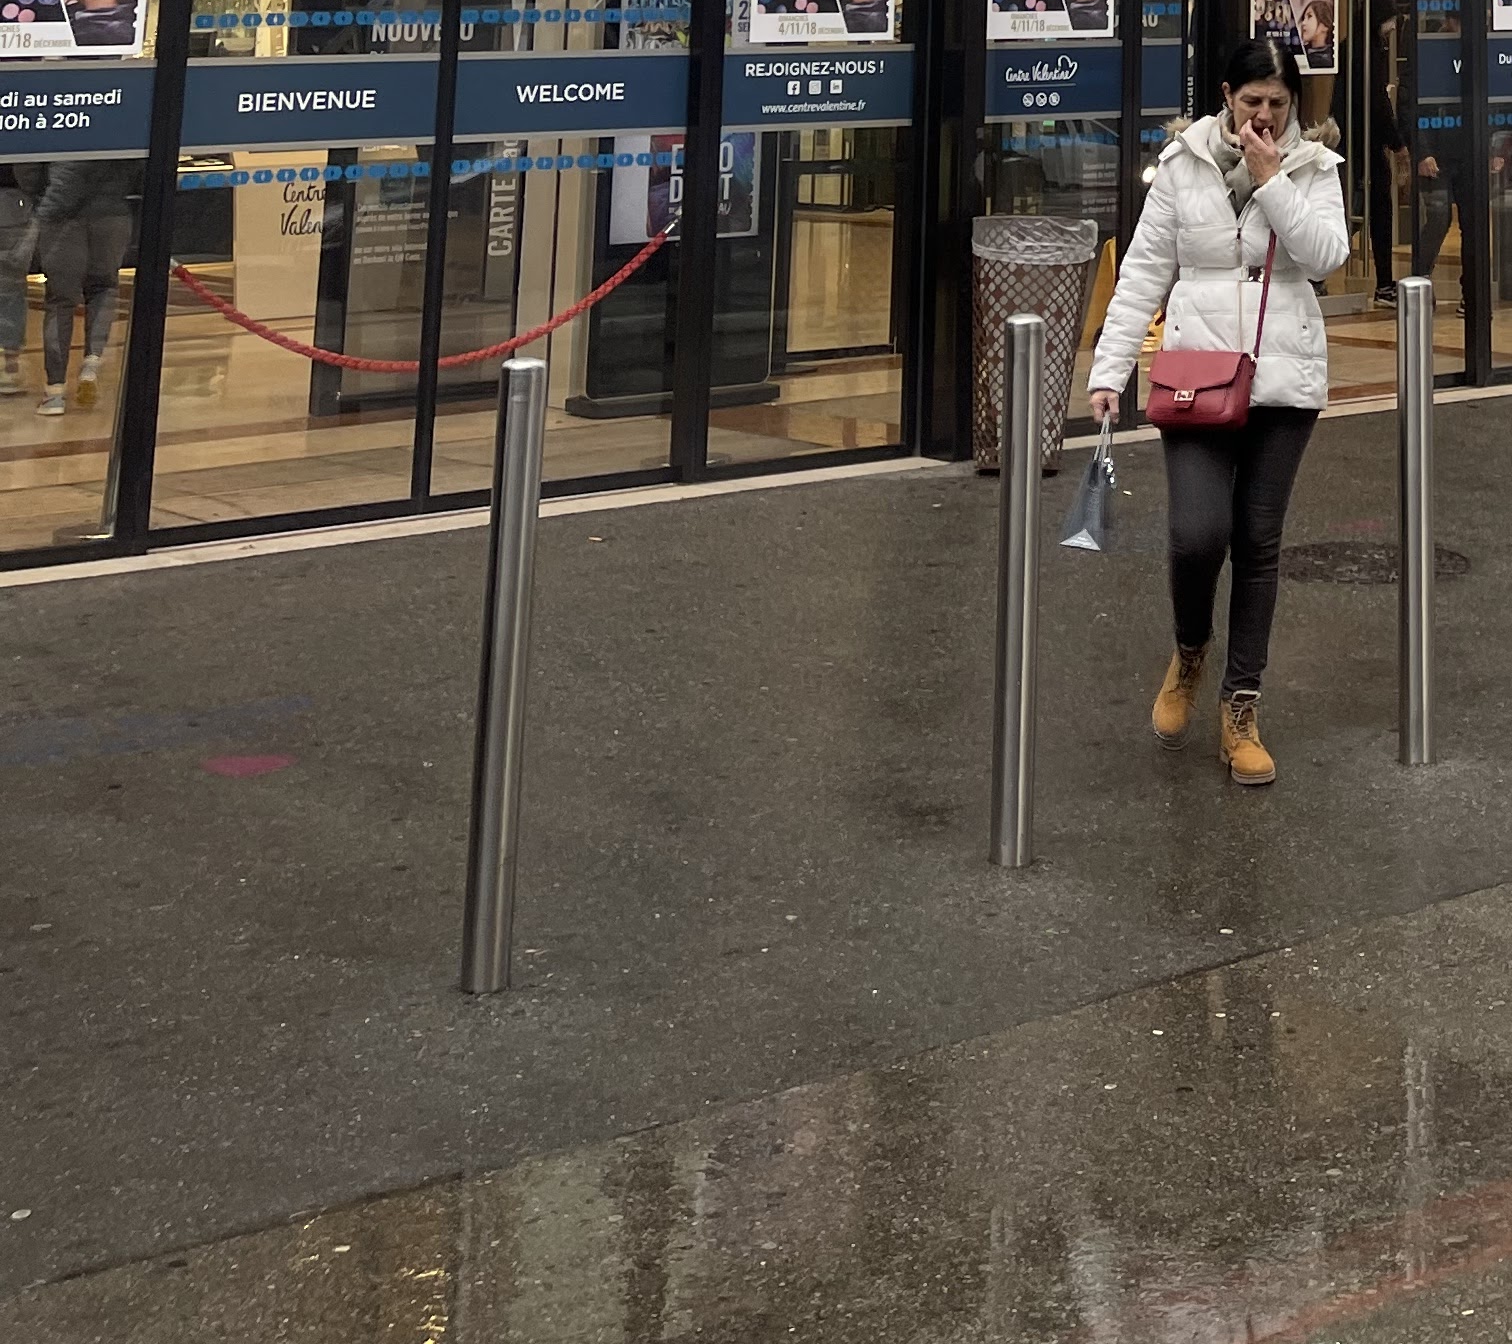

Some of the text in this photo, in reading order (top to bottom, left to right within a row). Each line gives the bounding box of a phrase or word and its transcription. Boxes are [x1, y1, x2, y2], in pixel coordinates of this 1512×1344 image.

[778, 22, 817, 35] 4/11/18
[1011, 20, 1045, 32] 4/11/18
[1499, 53, 1512, 64] Du
[745, 61, 876, 77] REJOIGNEZ-NOUS
[1005, 55, 1078, 83] Centre Valentine
[24, 94, 48, 107] au
[53, 88, 122, 106] samedi
[238, 90, 376, 112] BIENVENUE
[516, 82, 625, 103] WELCOME
[761, 100, 866, 114] www.centrevalentine.fr
[35, 112, 47, 129] à
[52, 112, 90, 129] 20h
[488, 178, 516, 257] CARTE
